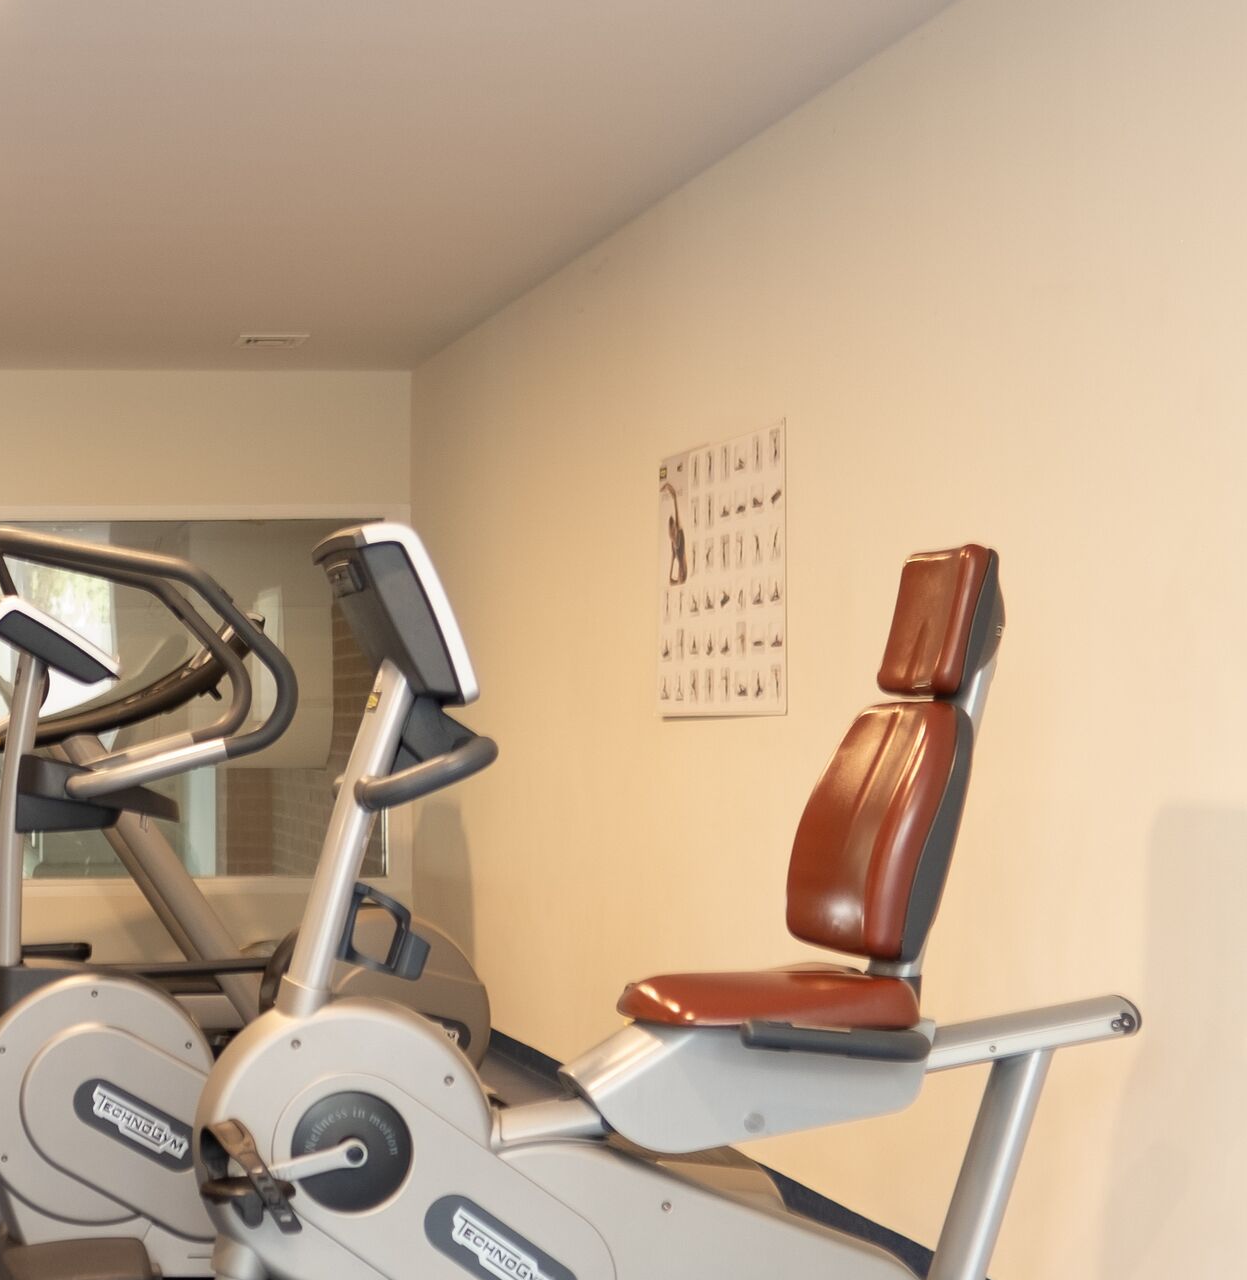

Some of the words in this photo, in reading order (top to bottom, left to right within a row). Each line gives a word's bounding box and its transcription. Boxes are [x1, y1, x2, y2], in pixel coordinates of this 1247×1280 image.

[96, 1089, 185, 1155] TECHNOGYM
[351, 1105, 366, 1119] in
[368, 1110, 399, 1156] motion
